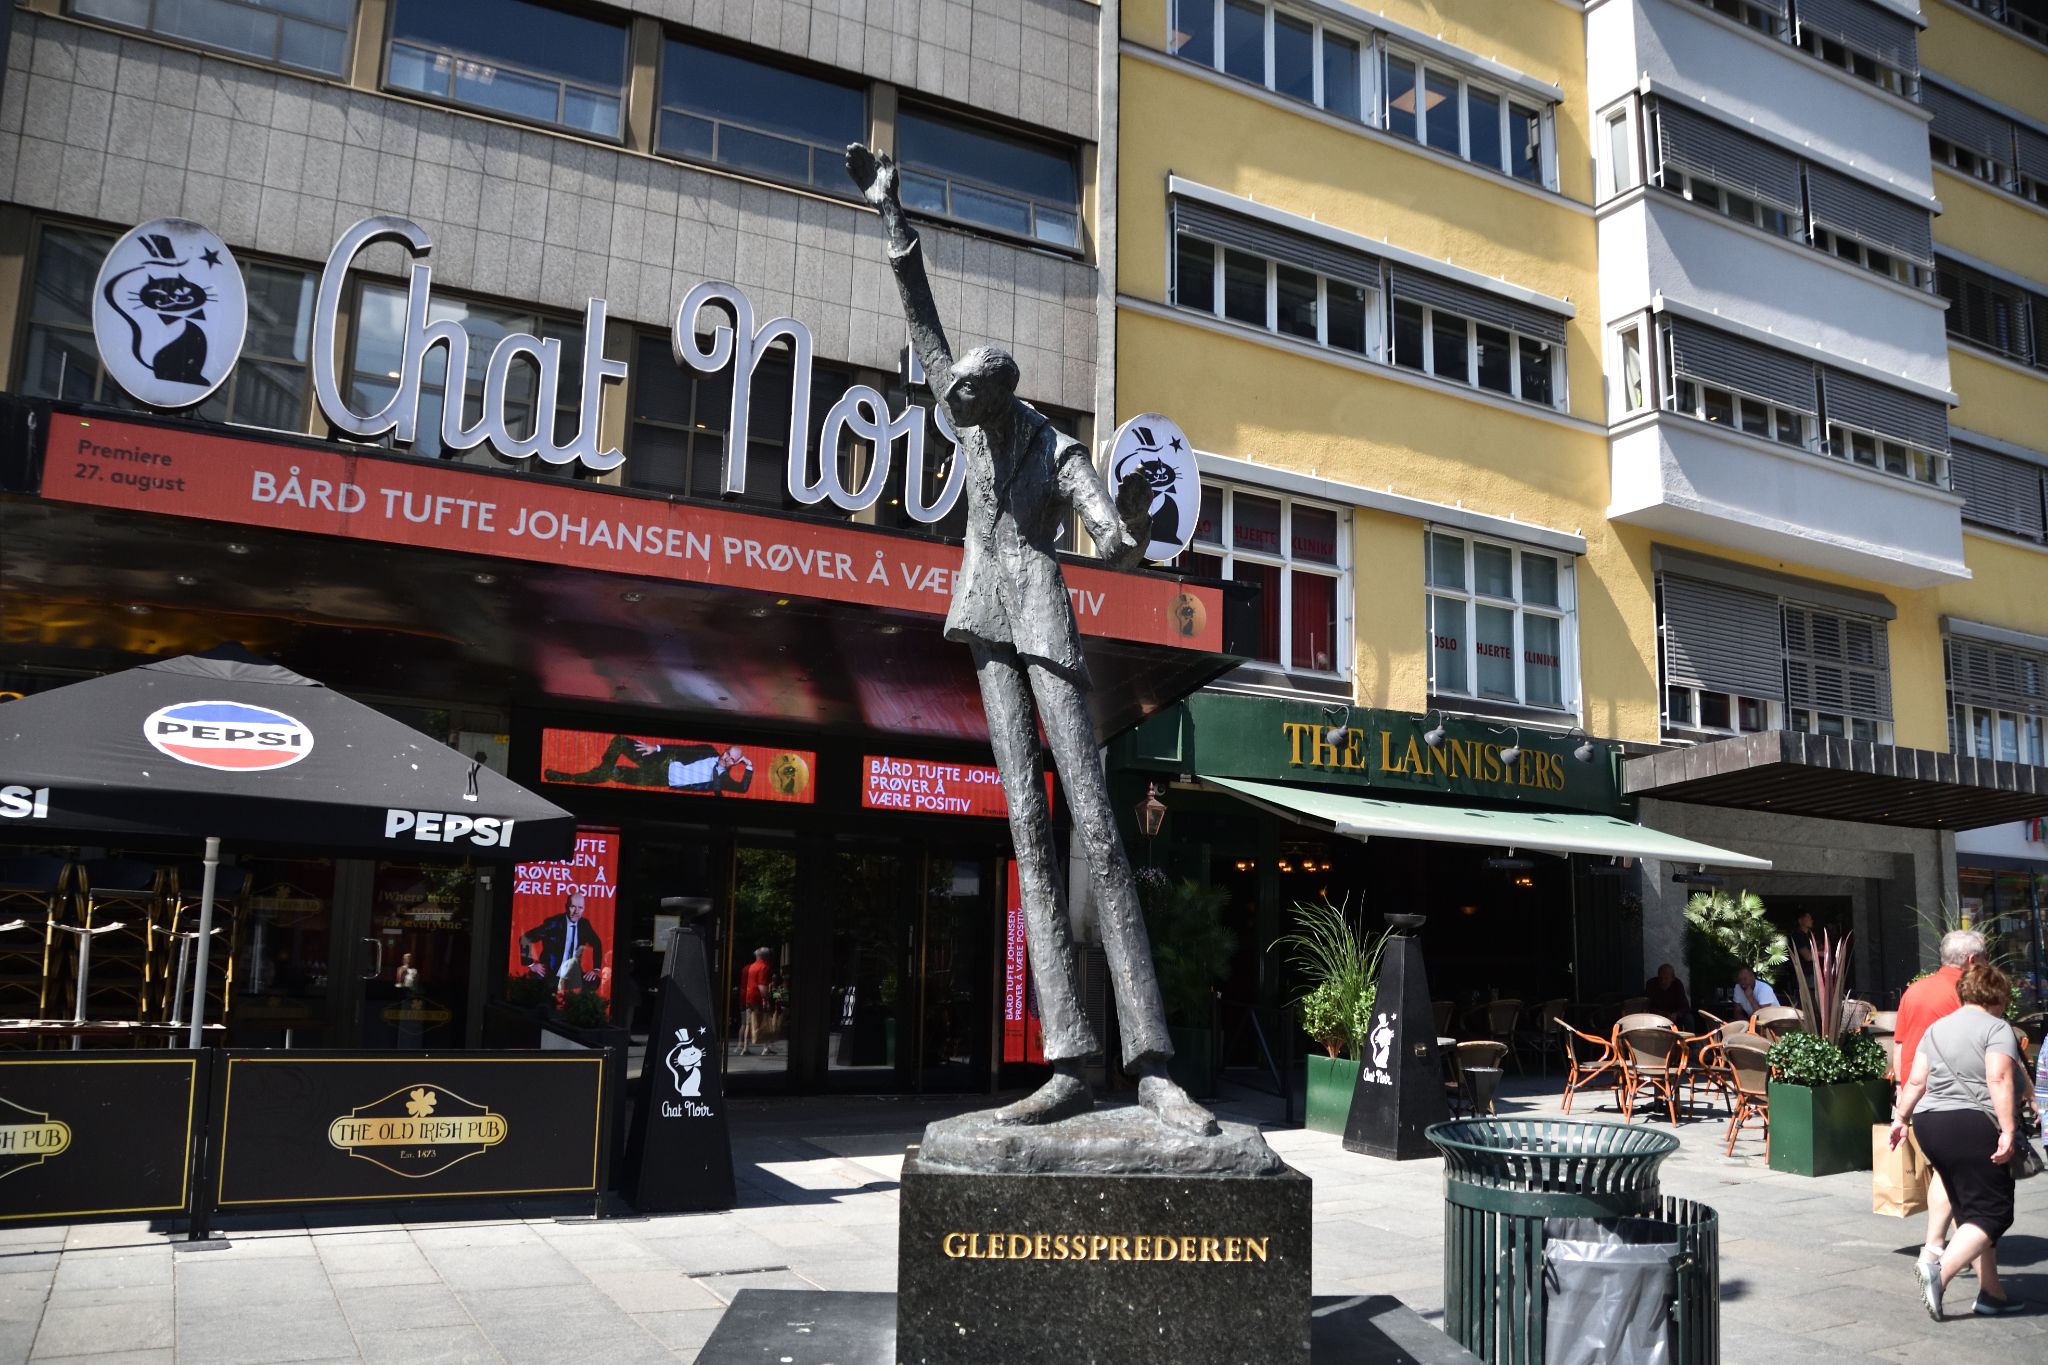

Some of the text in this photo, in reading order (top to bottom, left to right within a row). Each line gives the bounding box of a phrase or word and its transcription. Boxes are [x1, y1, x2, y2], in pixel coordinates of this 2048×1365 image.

[312, 215, 627, 471] Chat
[77, 439, 173, 467] Premiere
[74, 463, 186, 492] 27. august
[250, 465, 366, 514] BÅRD
[380, 488, 497, 533] TUFTE
[508, 507, 711, 562] JOHANSEN
[724, 535, 858, 583] PRØVER
[867, 549, 890, 587] Å
[1476, 642, 1511, 660] HJERTE
[156, 720, 303, 748] PEPSI
[1283, 722, 1565, 791] THE LANNISTERS
[871, 757, 913, 777] BÅRD
[917, 765, 960, 782] TUFTE
[870, 776, 945, 795] PRØVER Å
[868, 791, 971, 813] VÆRE POSITIV
[384, 809, 515, 849] PEPSI
[515, 865, 607, 882] RØVER Å
[513, 881, 616, 898] ÆRE POSITIV
[1005, 995, 1014, 1020] BÅRD
[661, 1100, 714, 1117] Chat Noir
[23, 1129, 62, 1148] PUB
[337, 1121, 500, 1142] THE OLD IRISH PUB
[942, 1232, 1270, 1263] GLEDESSPREDEREN
